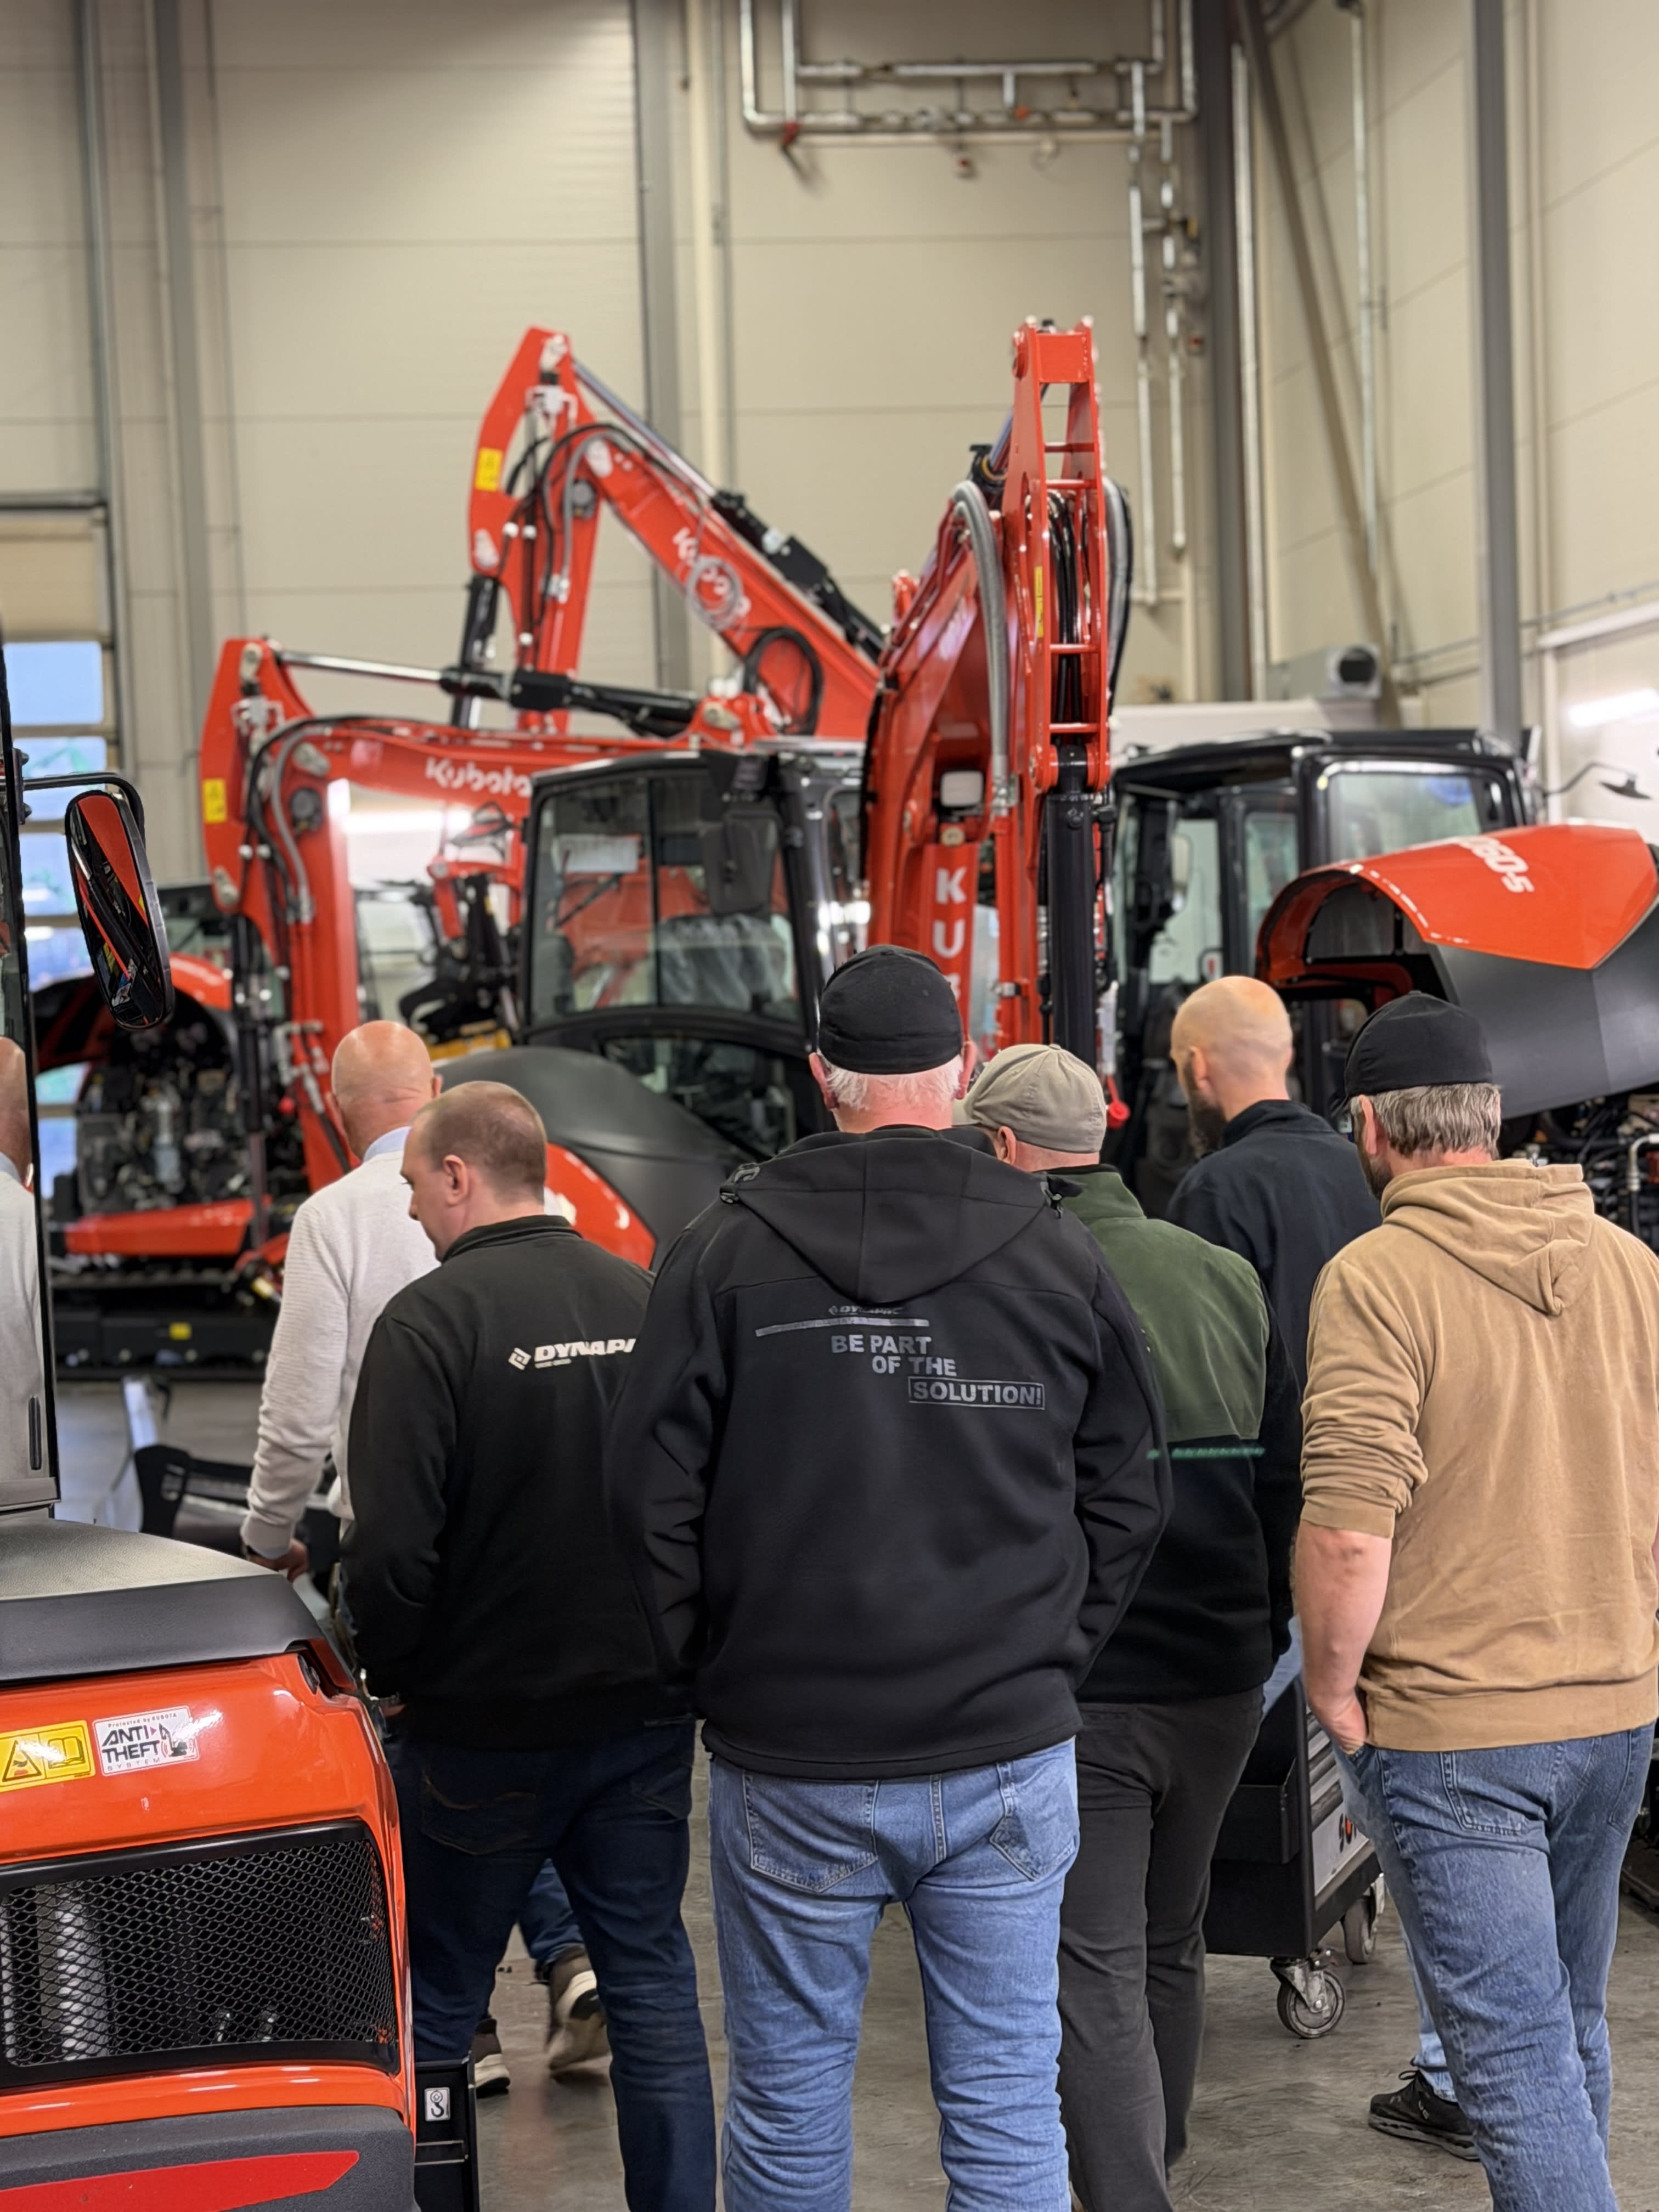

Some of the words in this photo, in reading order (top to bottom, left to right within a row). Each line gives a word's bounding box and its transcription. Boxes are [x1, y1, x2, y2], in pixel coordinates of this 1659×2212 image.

[672, 526, 752, 617] Kuoa
[425, 757, 533, 797] Kubota
[831, 1334, 864, 1353] BE
[870, 1335, 932, 1354] PART
[872, 1356, 900, 1374] OF
[909, 1357, 957, 1376] THE
[913, 1381, 1041, 1406] SOLUTION!
[101, 1725, 149, 1747] ANTI
[102, 1740, 160, 1763] THEFT
[107, 1757, 160, 1771] SYSTEM
